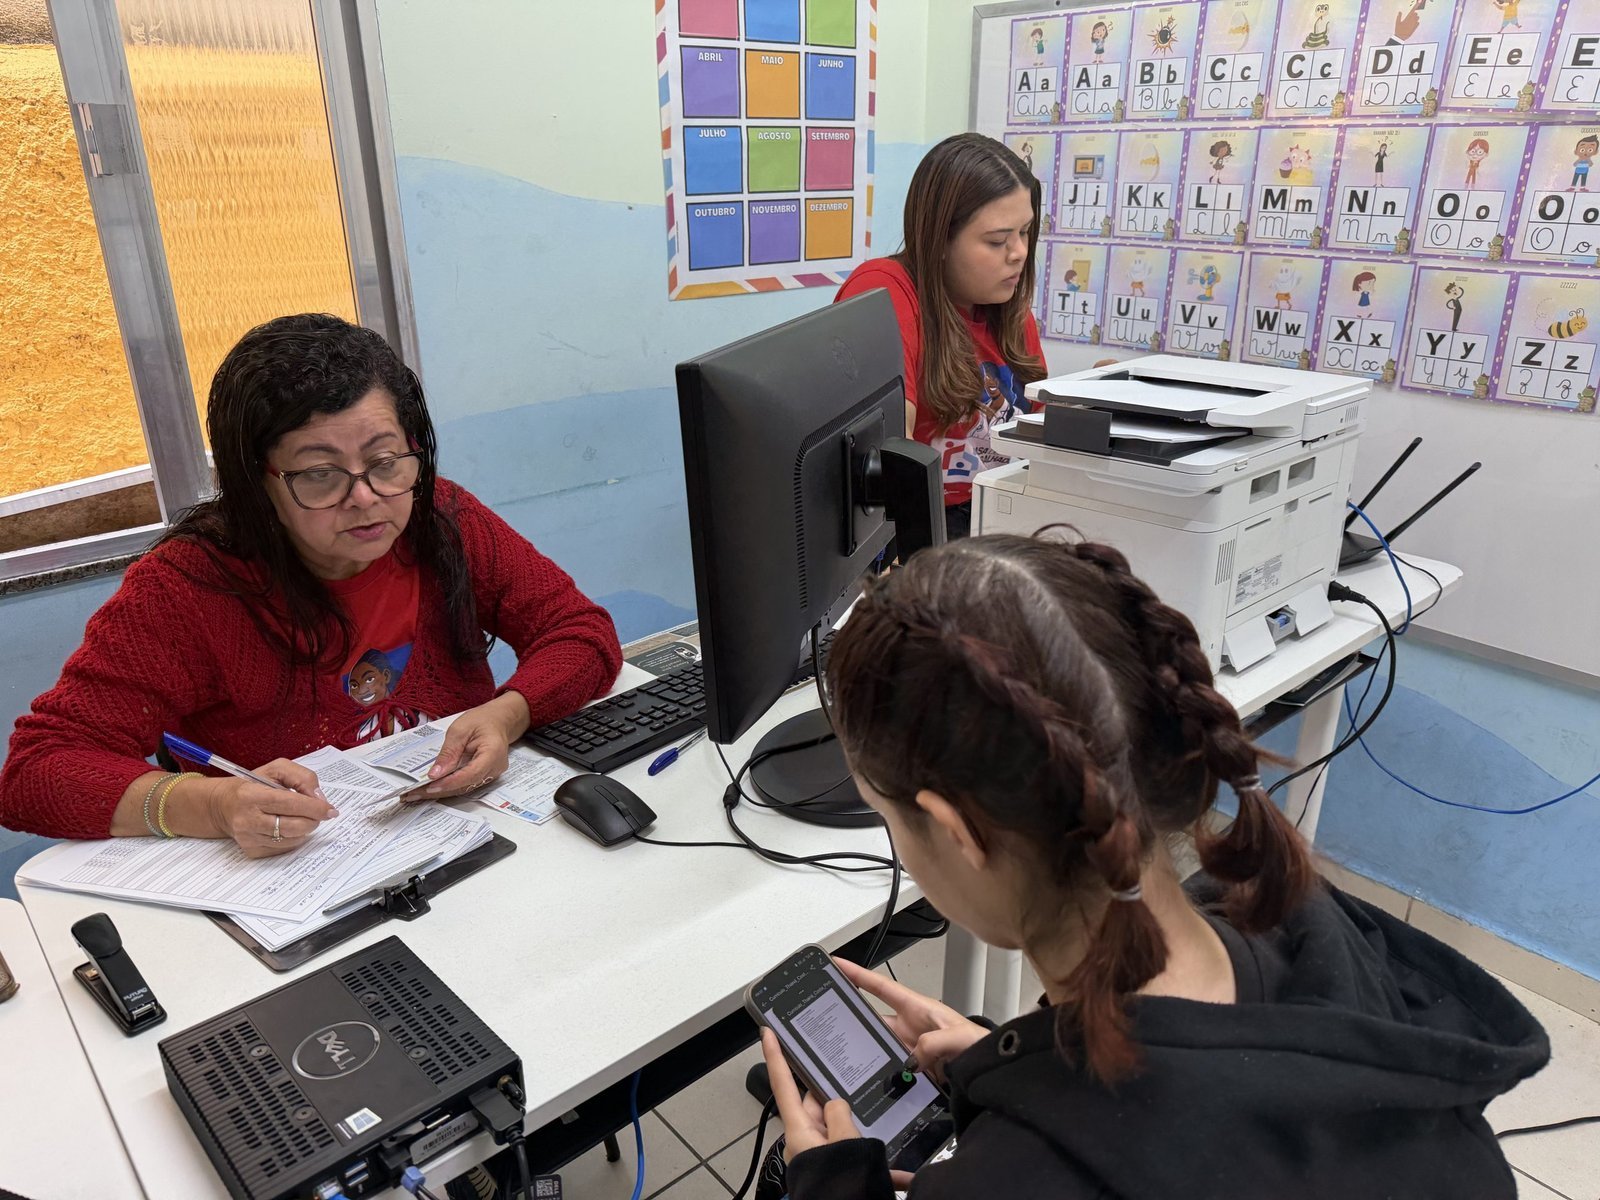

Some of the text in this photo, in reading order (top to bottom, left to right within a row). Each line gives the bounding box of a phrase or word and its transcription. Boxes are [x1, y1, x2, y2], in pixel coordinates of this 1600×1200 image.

[698, 52, 723, 61] ABRIL
[762, 56, 784, 64] MAIO
[1372, 50, 1424, 74] D d
[1468, 38, 1522, 65] E e
[1571, 38, 1599, 66] E
[818, 60, 843, 68] JUNHO
[1140, 62, 1177, 84] B b
[1210, 58, 1251, 81] C c
[1286, 54, 1332, 78] C c
[1018, 72, 1049, 91] A a
[1076, 68, 1112, 88] A a
[699, 129, 726, 138] JULHO
[758, 132, 791, 140] AGOSTO
[1069, 184, 1100, 205] J j
[1128, 185, 1142, 206] K
[1196, 186, 1208, 208] L
[1262, 189, 1312, 212] M m
[1348, 190, 1396, 214] N n
[1437, 193, 1460, 217] O
[695, 207, 735, 216] OUTUBRO
[752, 205, 796, 213] NOVEMBRO
[810, 203, 848, 211] DEZEMBRO
[1538, 195, 1564, 220] O
[1059, 293, 1088, 314] T t
[1117, 297, 1150, 320] U u
[1180, 305, 1218, 327] V v
[1256, 310, 1301, 335] W w
[1334, 320, 1383, 346] X x
[1426, 332, 1476, 359] Y y
[1522, 342, 1579, 370] Z z
[123, 987, 148, 1001] FUTURO
[316, 1030, 355, 1070] DELL
